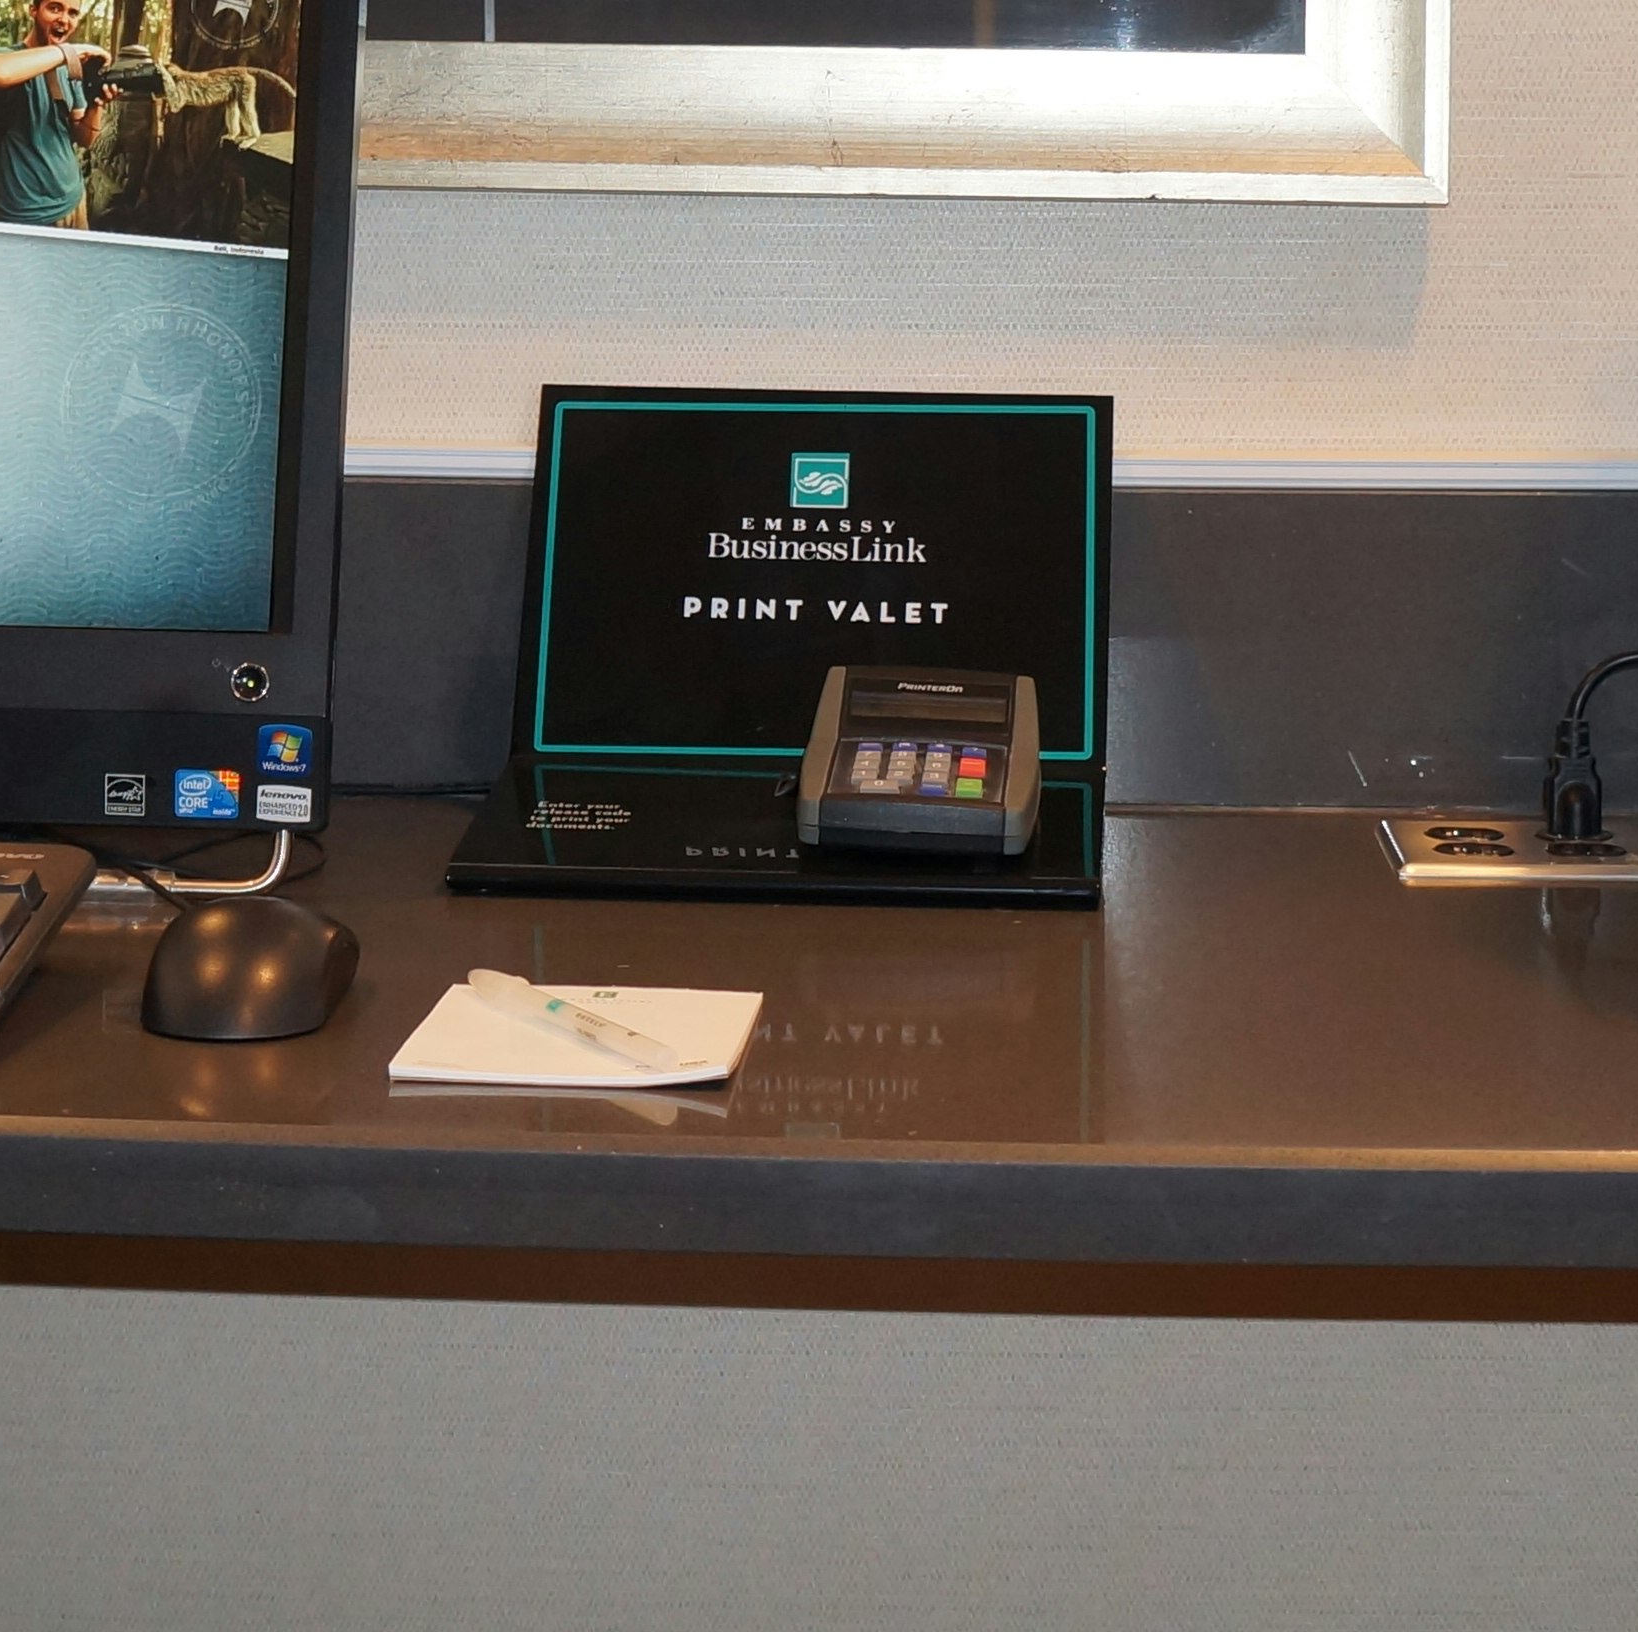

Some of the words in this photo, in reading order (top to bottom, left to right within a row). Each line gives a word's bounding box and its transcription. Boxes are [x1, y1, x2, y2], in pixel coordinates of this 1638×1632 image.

[742, 517, 897, 534] EMBASSY
[707, 532, 926, 564] BusinessLink
[683, 596, 804, 621] PRINT
[828, 600, 950, 625] VALET
[262, 761, 299, 771] Windows
[183, 777, 208, 790] intel
[260, 789, 308, 801] lenovo
[538, 800, 580, 809] Enter
